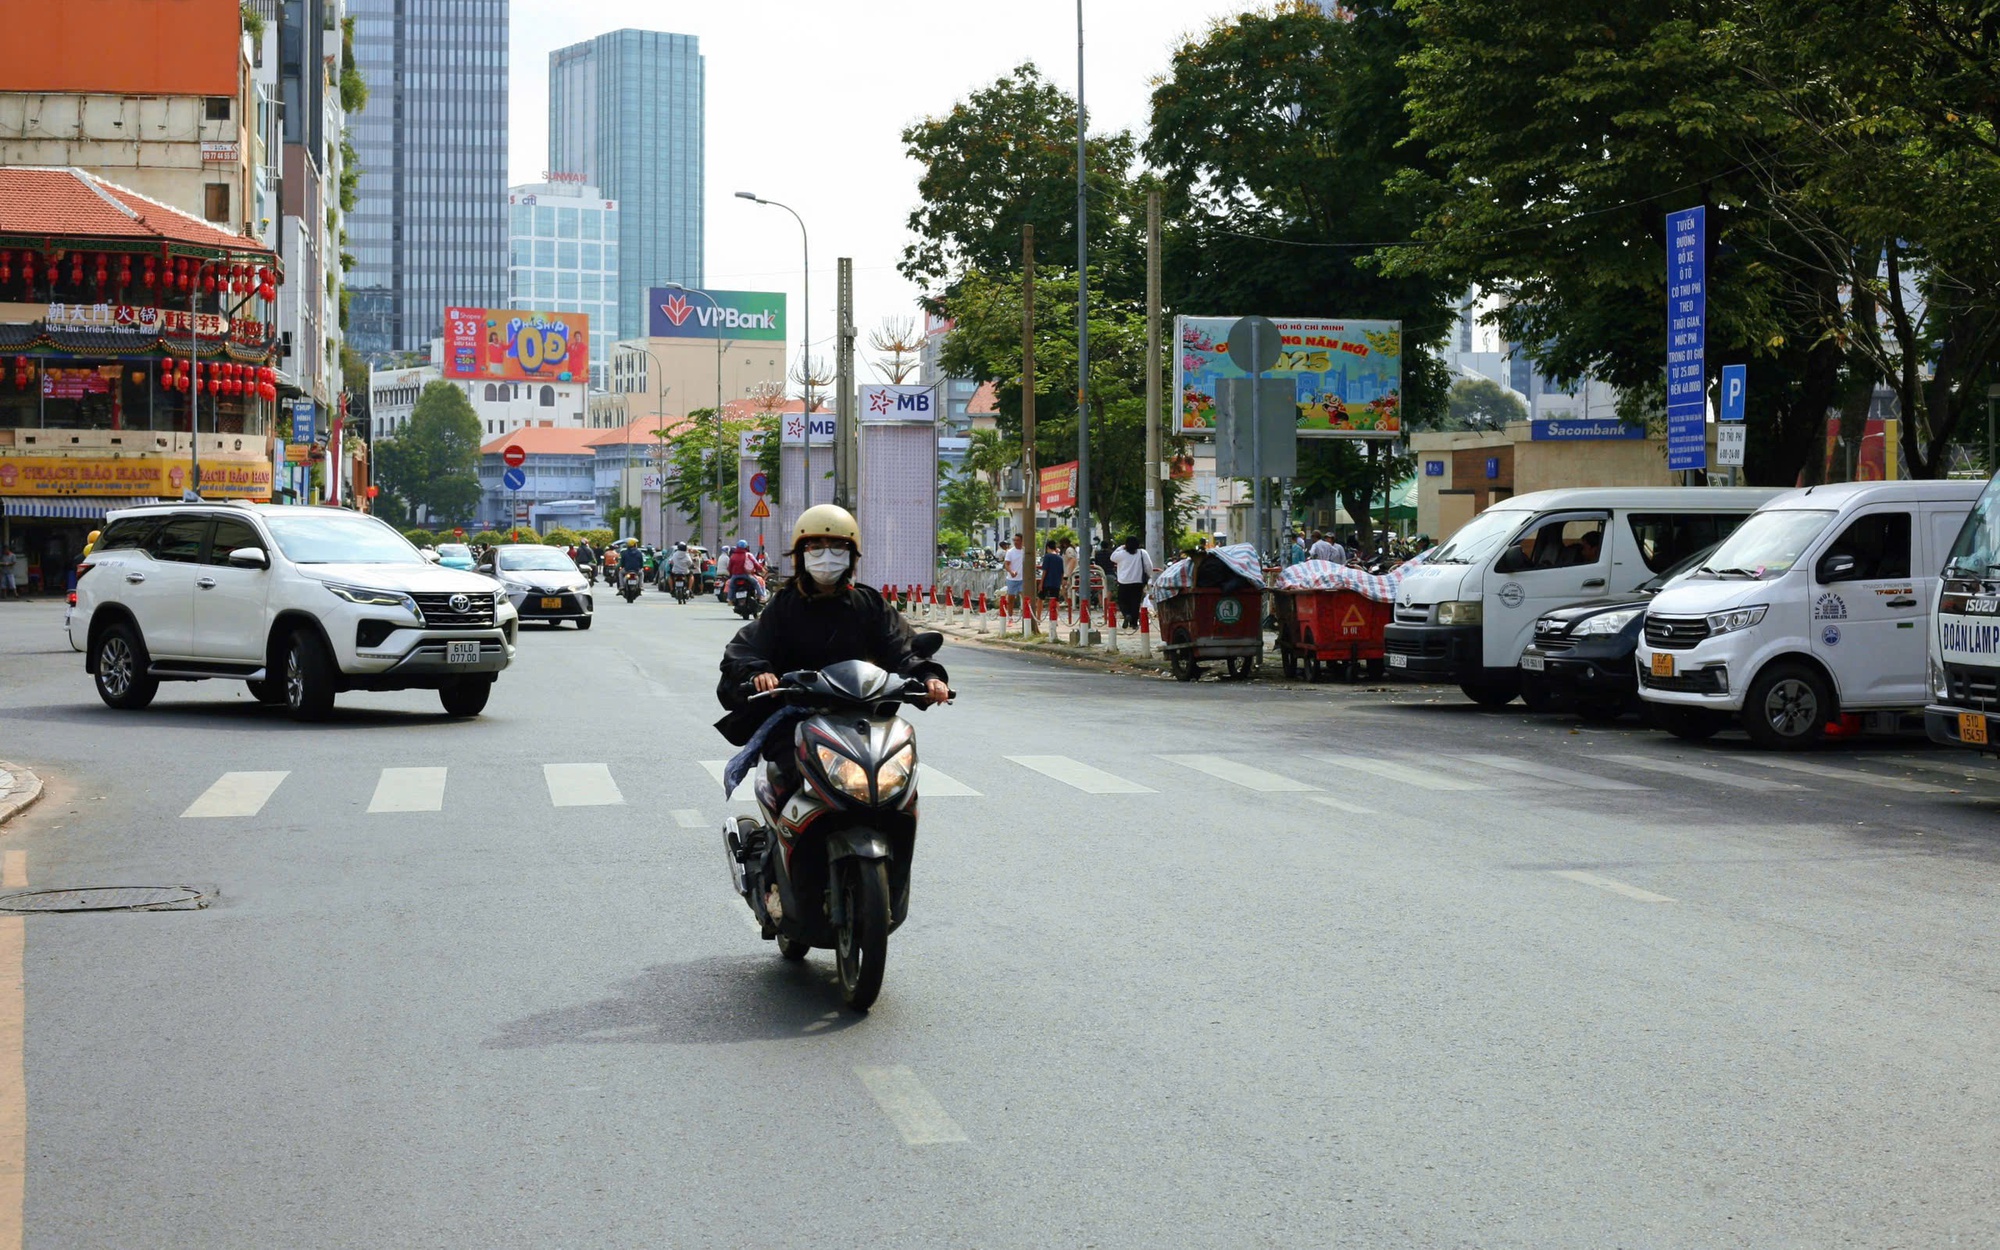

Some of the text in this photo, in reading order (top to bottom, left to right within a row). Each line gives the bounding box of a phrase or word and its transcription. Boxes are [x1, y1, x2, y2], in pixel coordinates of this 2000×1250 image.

[541, 171, 588, 182] SUNWAH
[522, 195, 537, 206] citi
[1676, 214, 1695, 232] TUYẾN
[1676, 233, 1696, 249] ĐƯỜNG
[1686, 251, 1694, 263] XE
[1679, 265, 1692, 281] Ô TÔ
[1671, 279, 1702, 298] CÓ THU PHÍ
[1679, 300, 1694, 313] THEO
[460, 312, 481, 320] Shopee
[696, 306, 776, 329] VPBank
[1673, 316, 1686, 331] THỜI
[1290, 323, 1302, 331] HỒ
[1304, 323, 1319, 331] CHÍ
[1305, 335, 1339, 349] NĂM
[1341, 340, 1370, 357] MỚI
[1674, 330, 1698, 347] MỨC PHÍ
[1275, 350, 1332, 372] 025
[1669, 345, 1704, 363] TRONG 01 GIỜ
[1670, 380, 1682, 396] ĐẾN
[1729, 378, 1741, 407] P
[897, 394, 929, 412] MB
[809, 421, 836, 435] MB
[1547, 422, 1626, 436] Sacombank
[81, 464, 113, 480] BẢO
[1965, 599, 1998, 613] ISUZU
[454, 643, 474, 653] 61LD
[450, 653, 477, 663] 077.00
[1965, 715, 1979, 728] 51D
